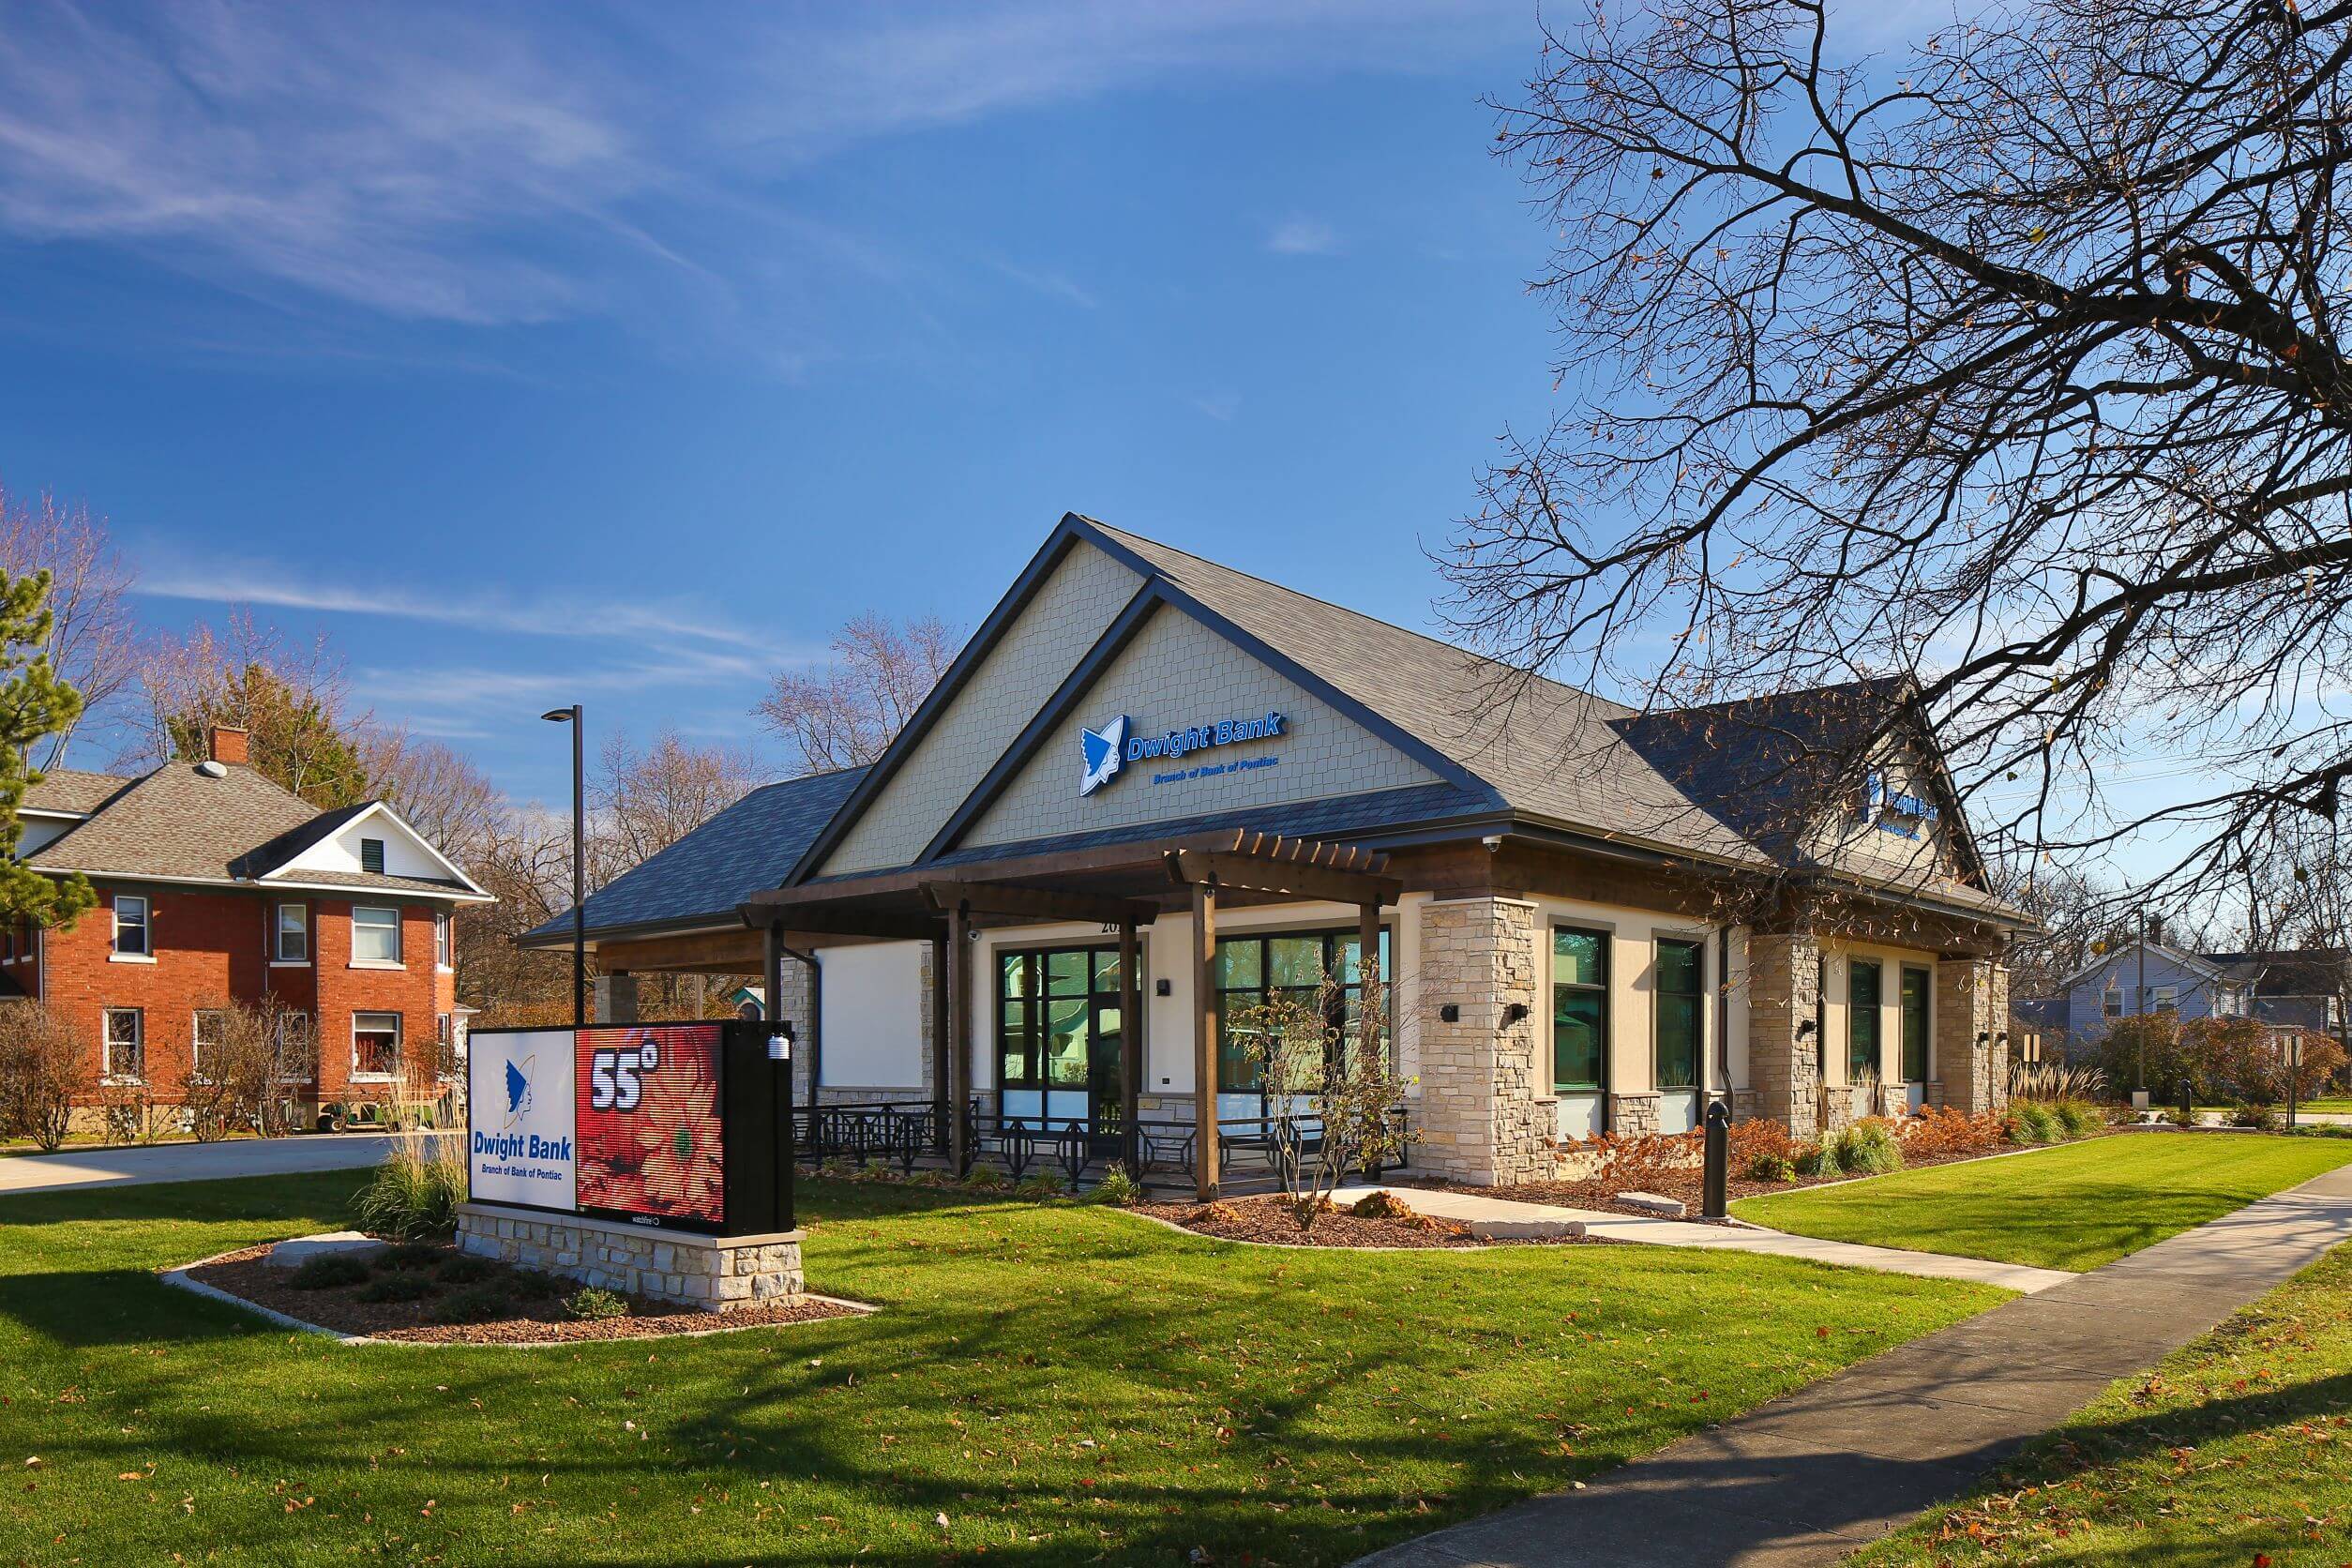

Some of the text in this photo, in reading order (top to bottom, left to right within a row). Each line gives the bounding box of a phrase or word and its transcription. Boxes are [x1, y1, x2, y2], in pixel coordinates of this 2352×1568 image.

[1127, 711, 1282, 761] Dwight Bank
[1153, 756, 1279, 785] Branch of Bank of Pontiac
[1101, 922, 1121, 933] 20
[474, 1131, 571, 1161] Dwight Bank
[481, 1164, 563, 1181] Branch of Bank of Pontiac
